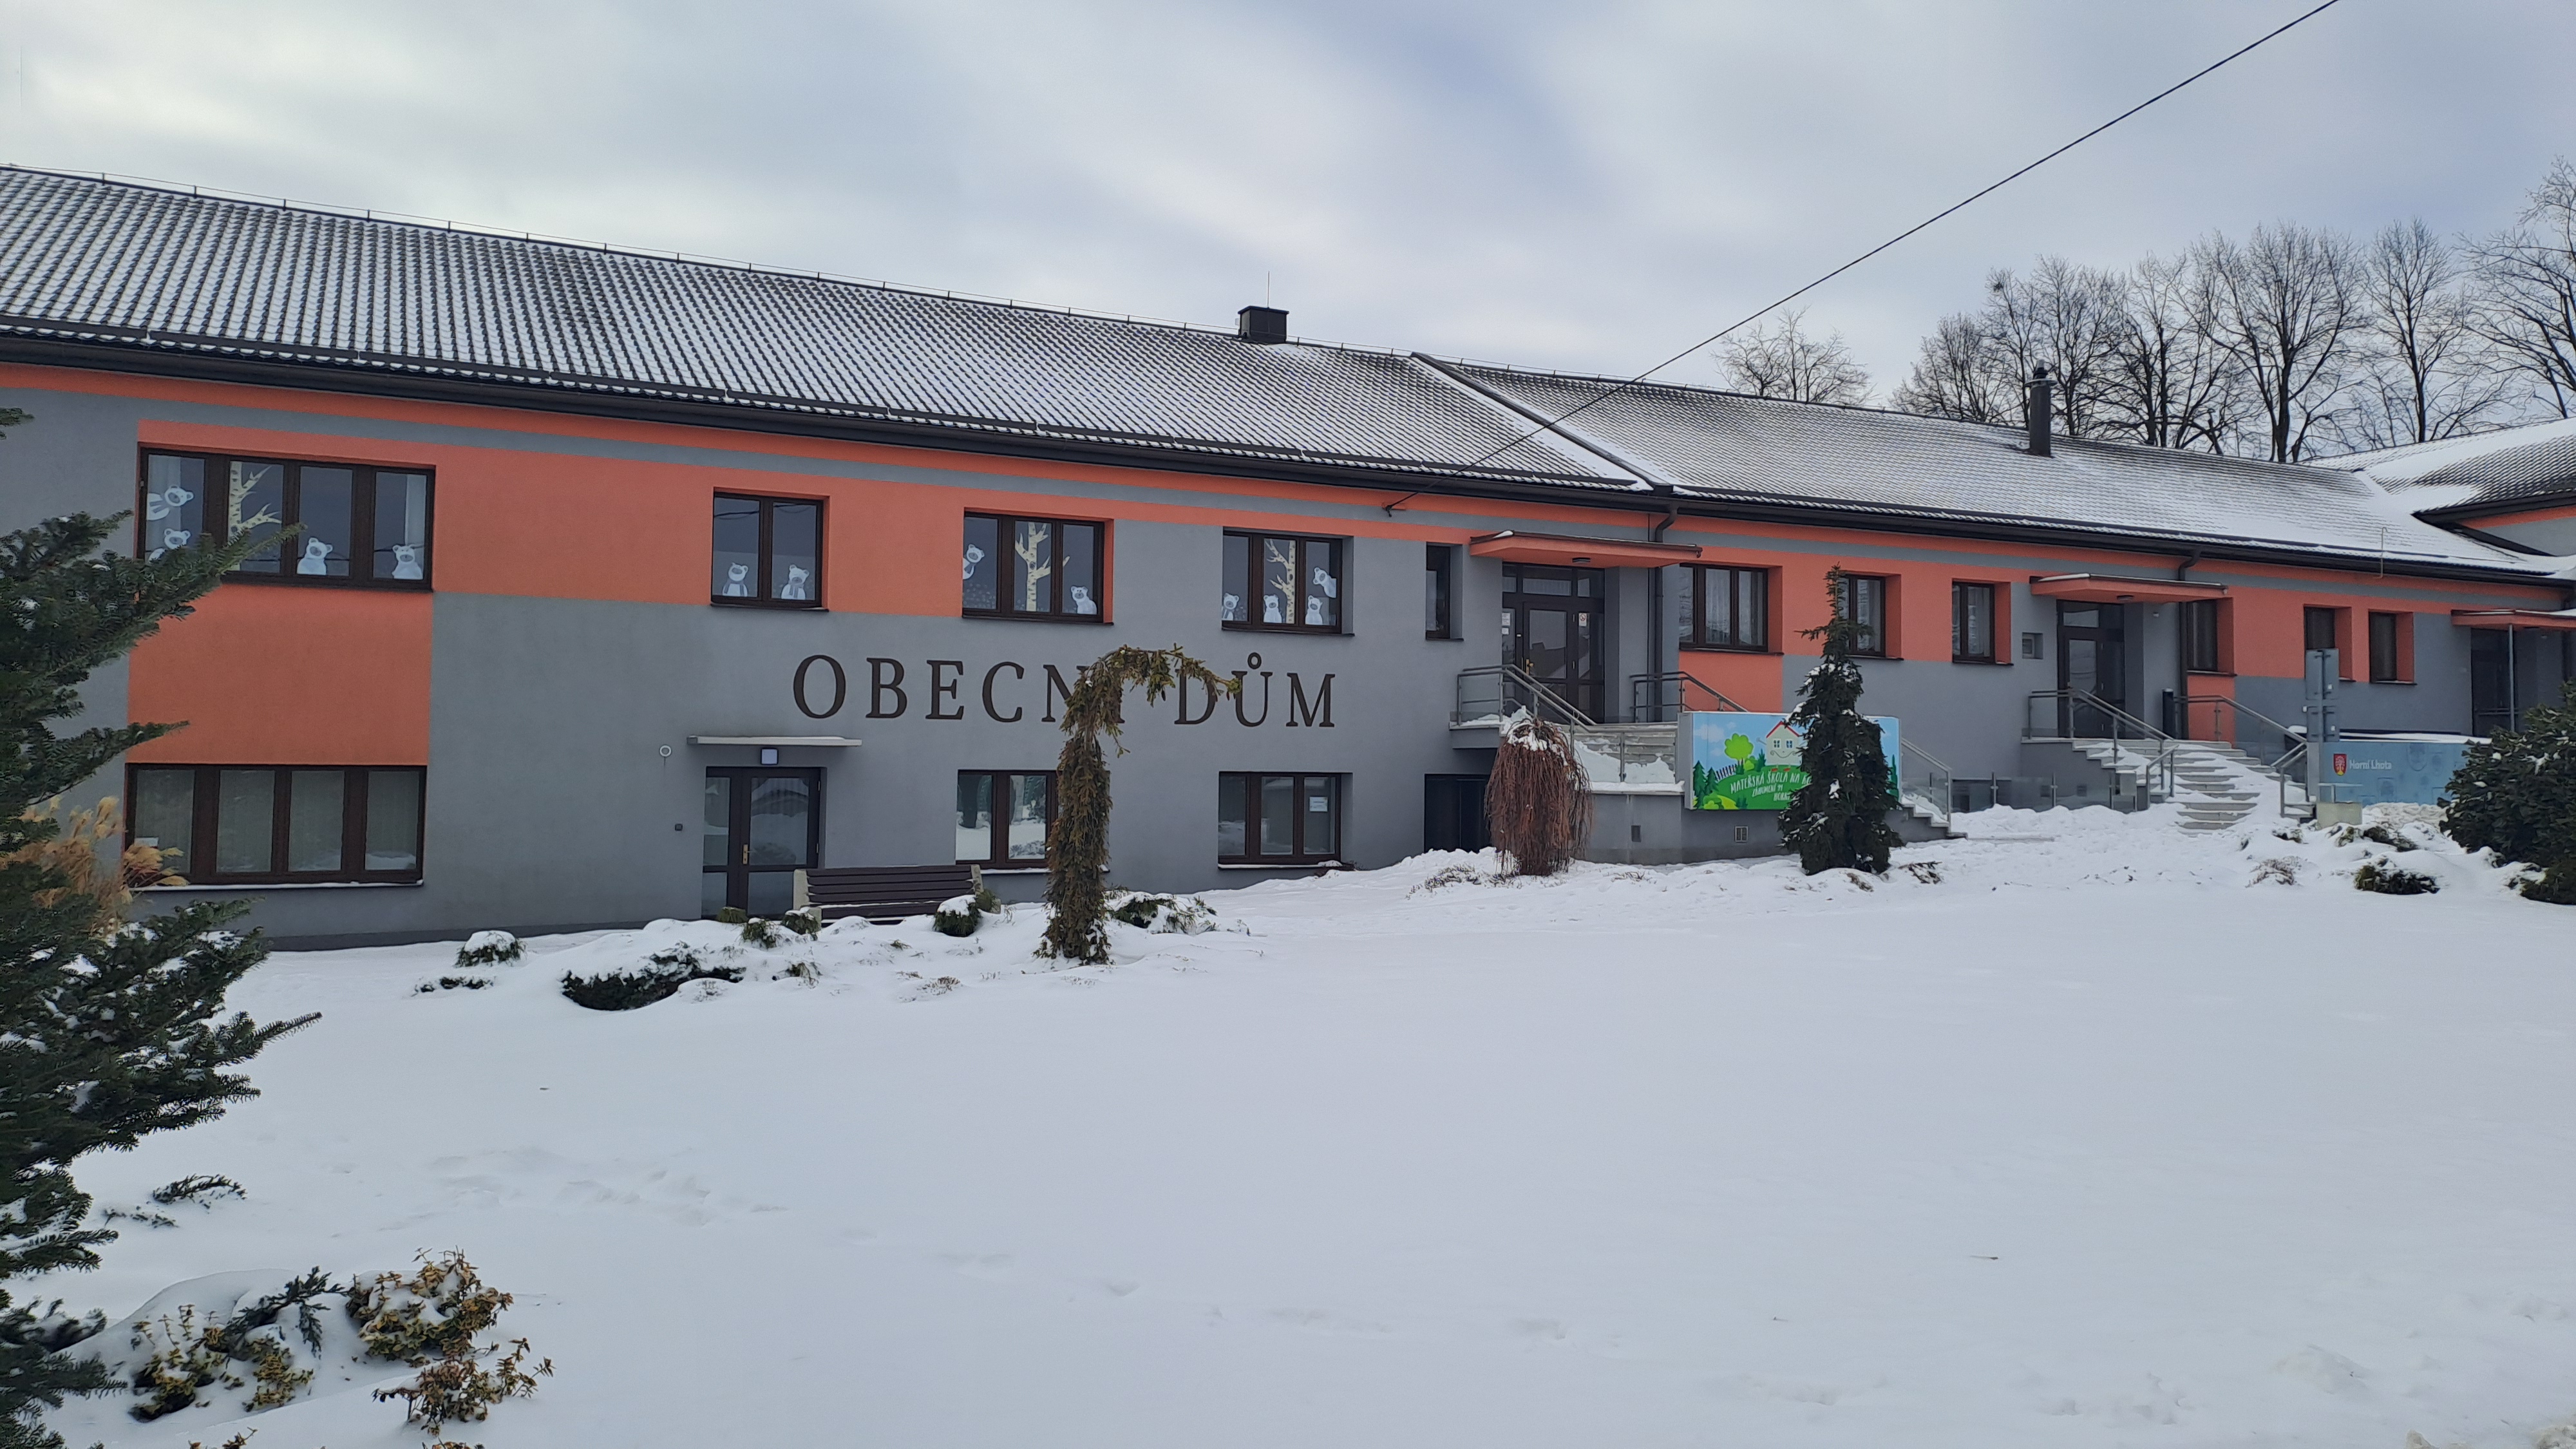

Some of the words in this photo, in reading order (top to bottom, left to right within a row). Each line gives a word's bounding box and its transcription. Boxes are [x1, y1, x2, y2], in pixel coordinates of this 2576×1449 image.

[793, 654, 1126, 724] OBECN
[1174, 652, 1335, 728] DŮM
[2371, 759, 2392, 770] Lhota
[1730, 772, 1765, 795] MATEŘSKÁ
[1766, 771, 1788, 784] ŠKOLA
[1790, 773, 1801, 784] NA
